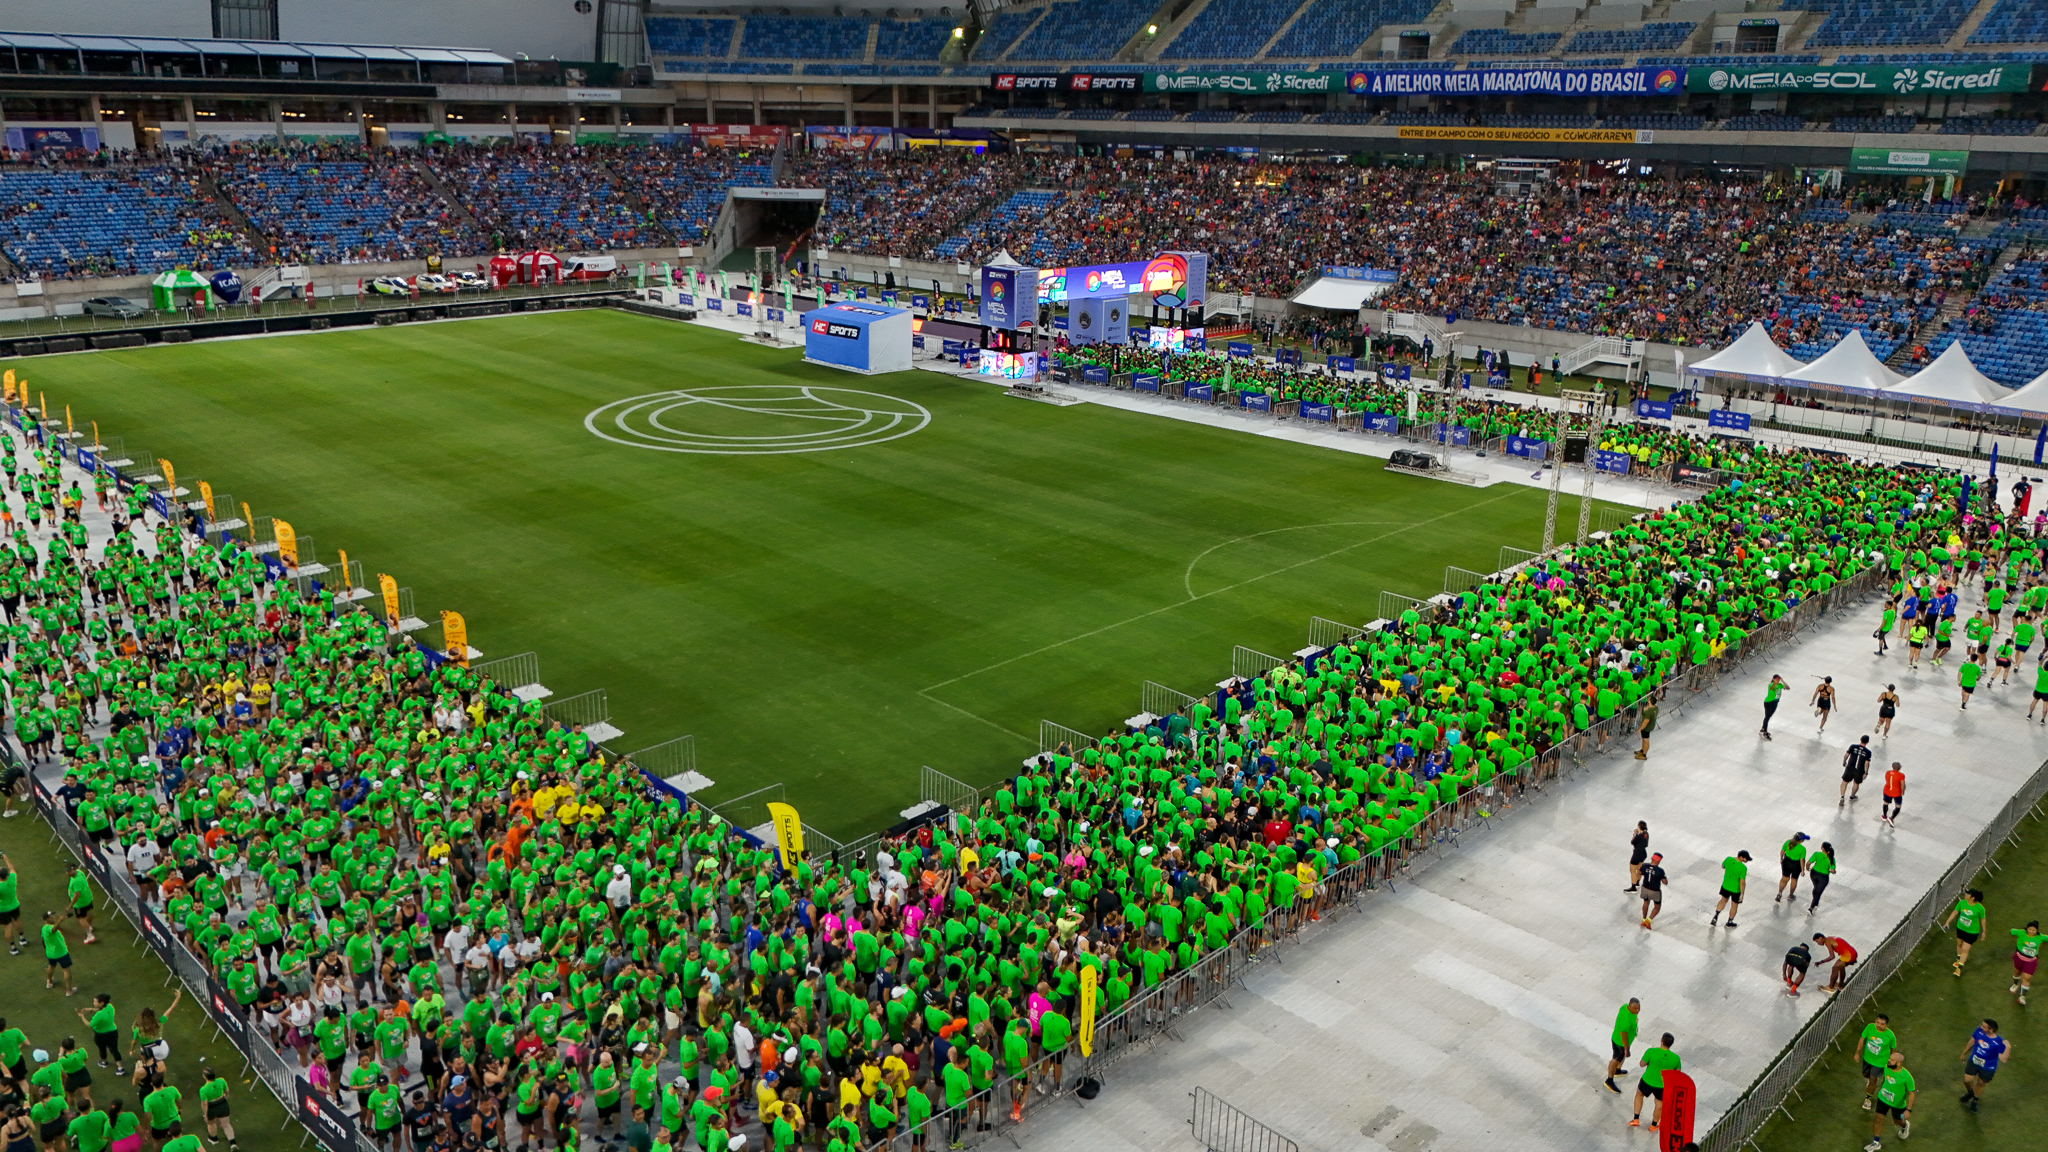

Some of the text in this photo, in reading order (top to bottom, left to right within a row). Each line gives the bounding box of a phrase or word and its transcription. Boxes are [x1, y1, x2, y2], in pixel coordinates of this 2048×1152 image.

[998, 77, 1057, 88] HC SPORTS
[1073, 77, 1136, 88] HC SPORTS
[1169, 76, 1212, 89] MEIA
[1220, 76, 1257, 90] SOL
[1282, 75, 1330, 90] Sicredi
[1372, 70, 1648, 93] A MELHOR MEIA MARATONA DO BRASIL
[1730, 72, 1799, 89] MEIA
[1813, 72, 1876, 88] SOL
[1921, 67, 2003, 90] Sicredi
[1400, 129, 1550, 139] ENTRE EM CAMPO COM O SEU NEGÓCIO
[814, 322, 858, 337] HC SPORTS
[1809, 382, 1825, 390] POSTO
[1911, 395, 1928, 403] POSTO
[785, 818, 795, 849] SPORTS
[1674, 1091, 1684, 1131] SPORTS
[307, 1099, 318, 1113] HC
[319, 1109, 347, 1139] SPORTS
